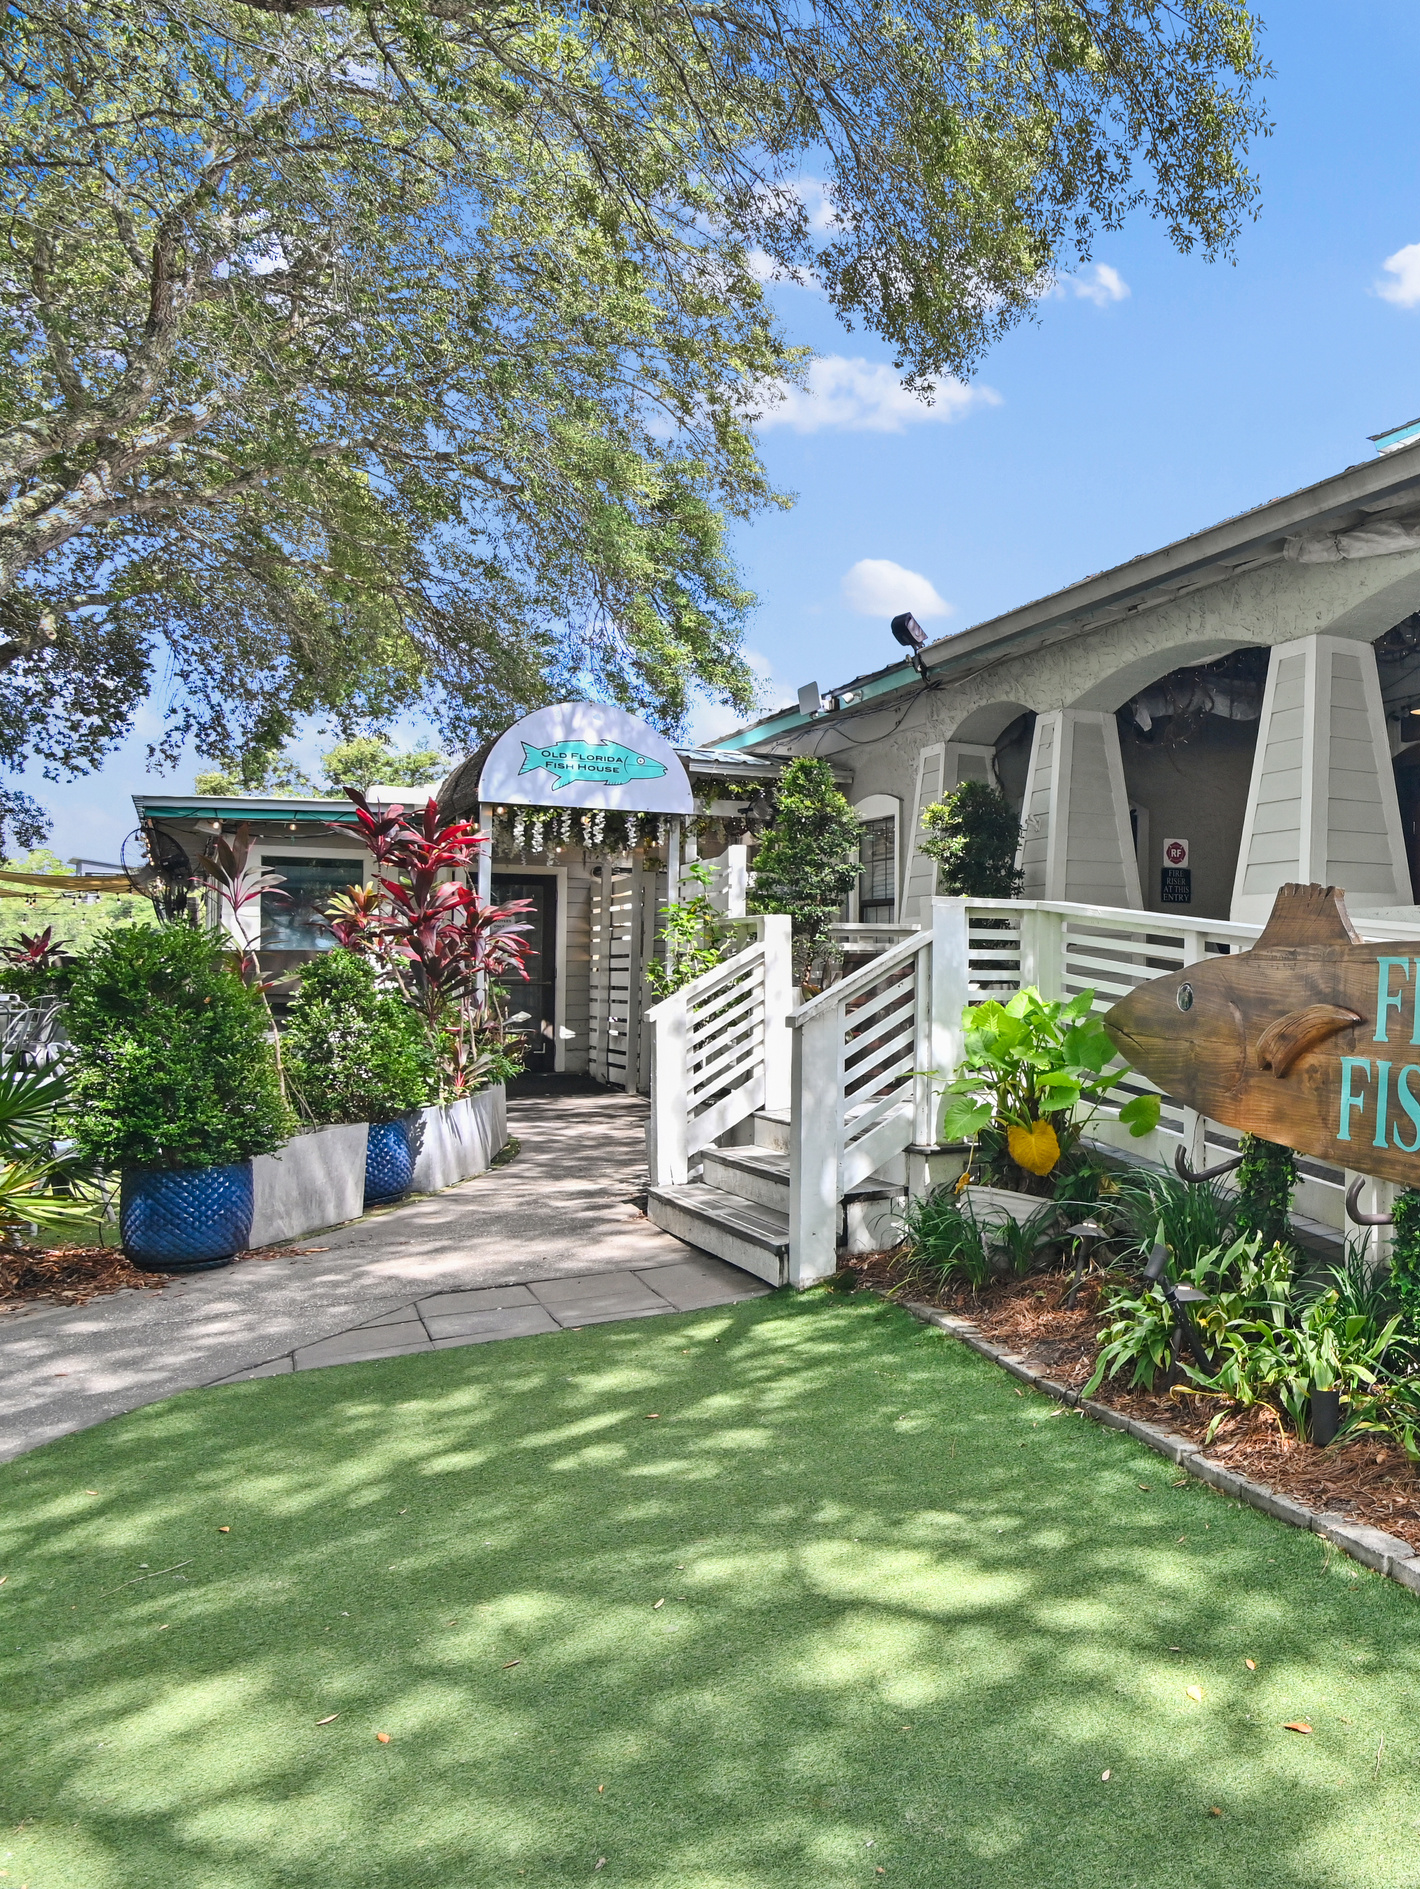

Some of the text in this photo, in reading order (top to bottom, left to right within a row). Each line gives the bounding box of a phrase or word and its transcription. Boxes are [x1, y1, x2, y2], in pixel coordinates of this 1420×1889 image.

[541, 750, 624, 763] OLD FLORIDA
[545, 761, 620, 773] FISH HOUSE
[1171, 849, 1182, 858] RF
[1168, 869, 1185, 877] FIRE
[1166, 877, 1186, 886] RISER
[1163, 885, 1173, 893] AT
[1163, 893, 1190, 902] ENTRY
